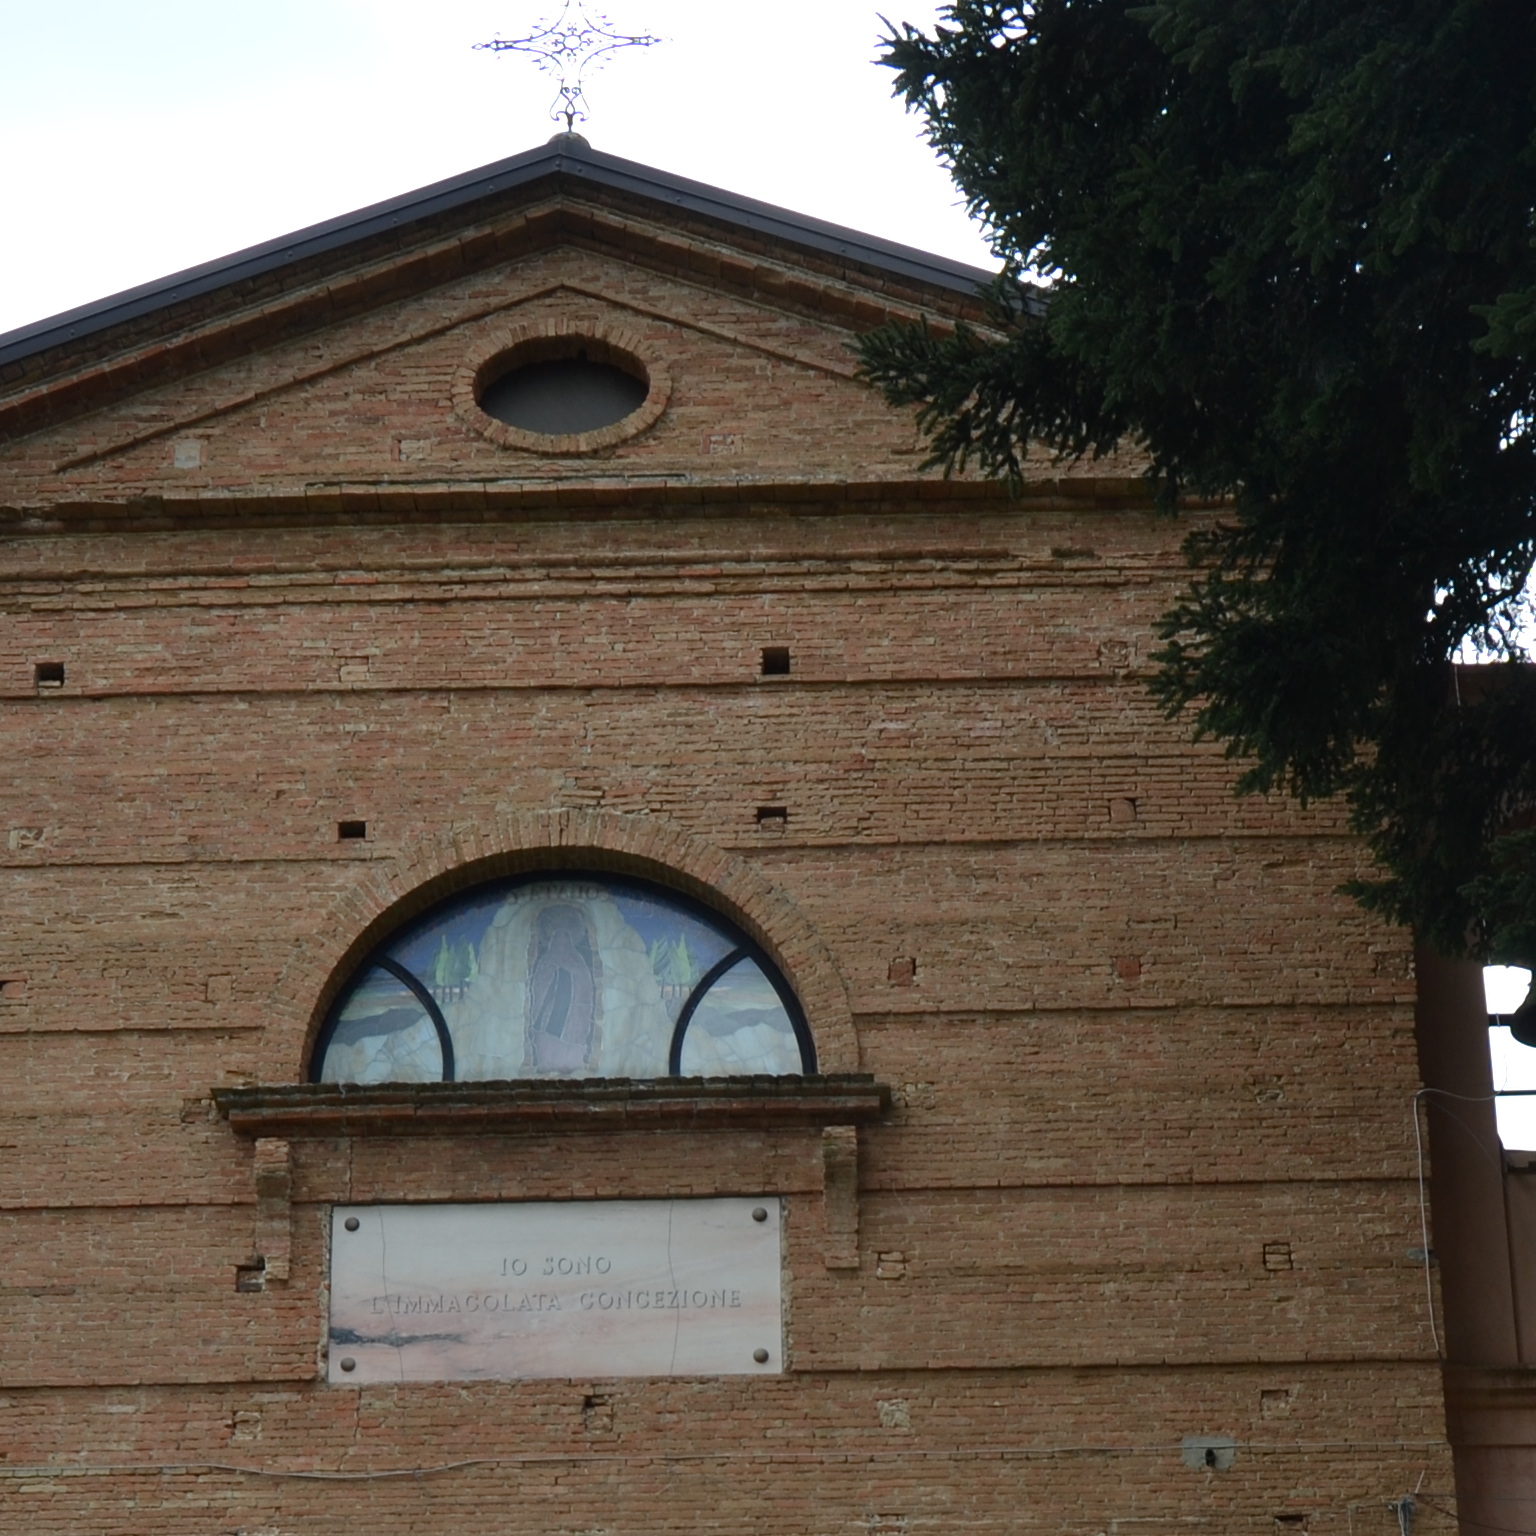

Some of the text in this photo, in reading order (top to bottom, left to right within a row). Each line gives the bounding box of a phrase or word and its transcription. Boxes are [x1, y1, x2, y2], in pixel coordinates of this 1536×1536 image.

[500, 1255, 613, 1277] IO SONO
[369, 1289, 743, 1315] L'IMMACOLATA CONCEZIONE
